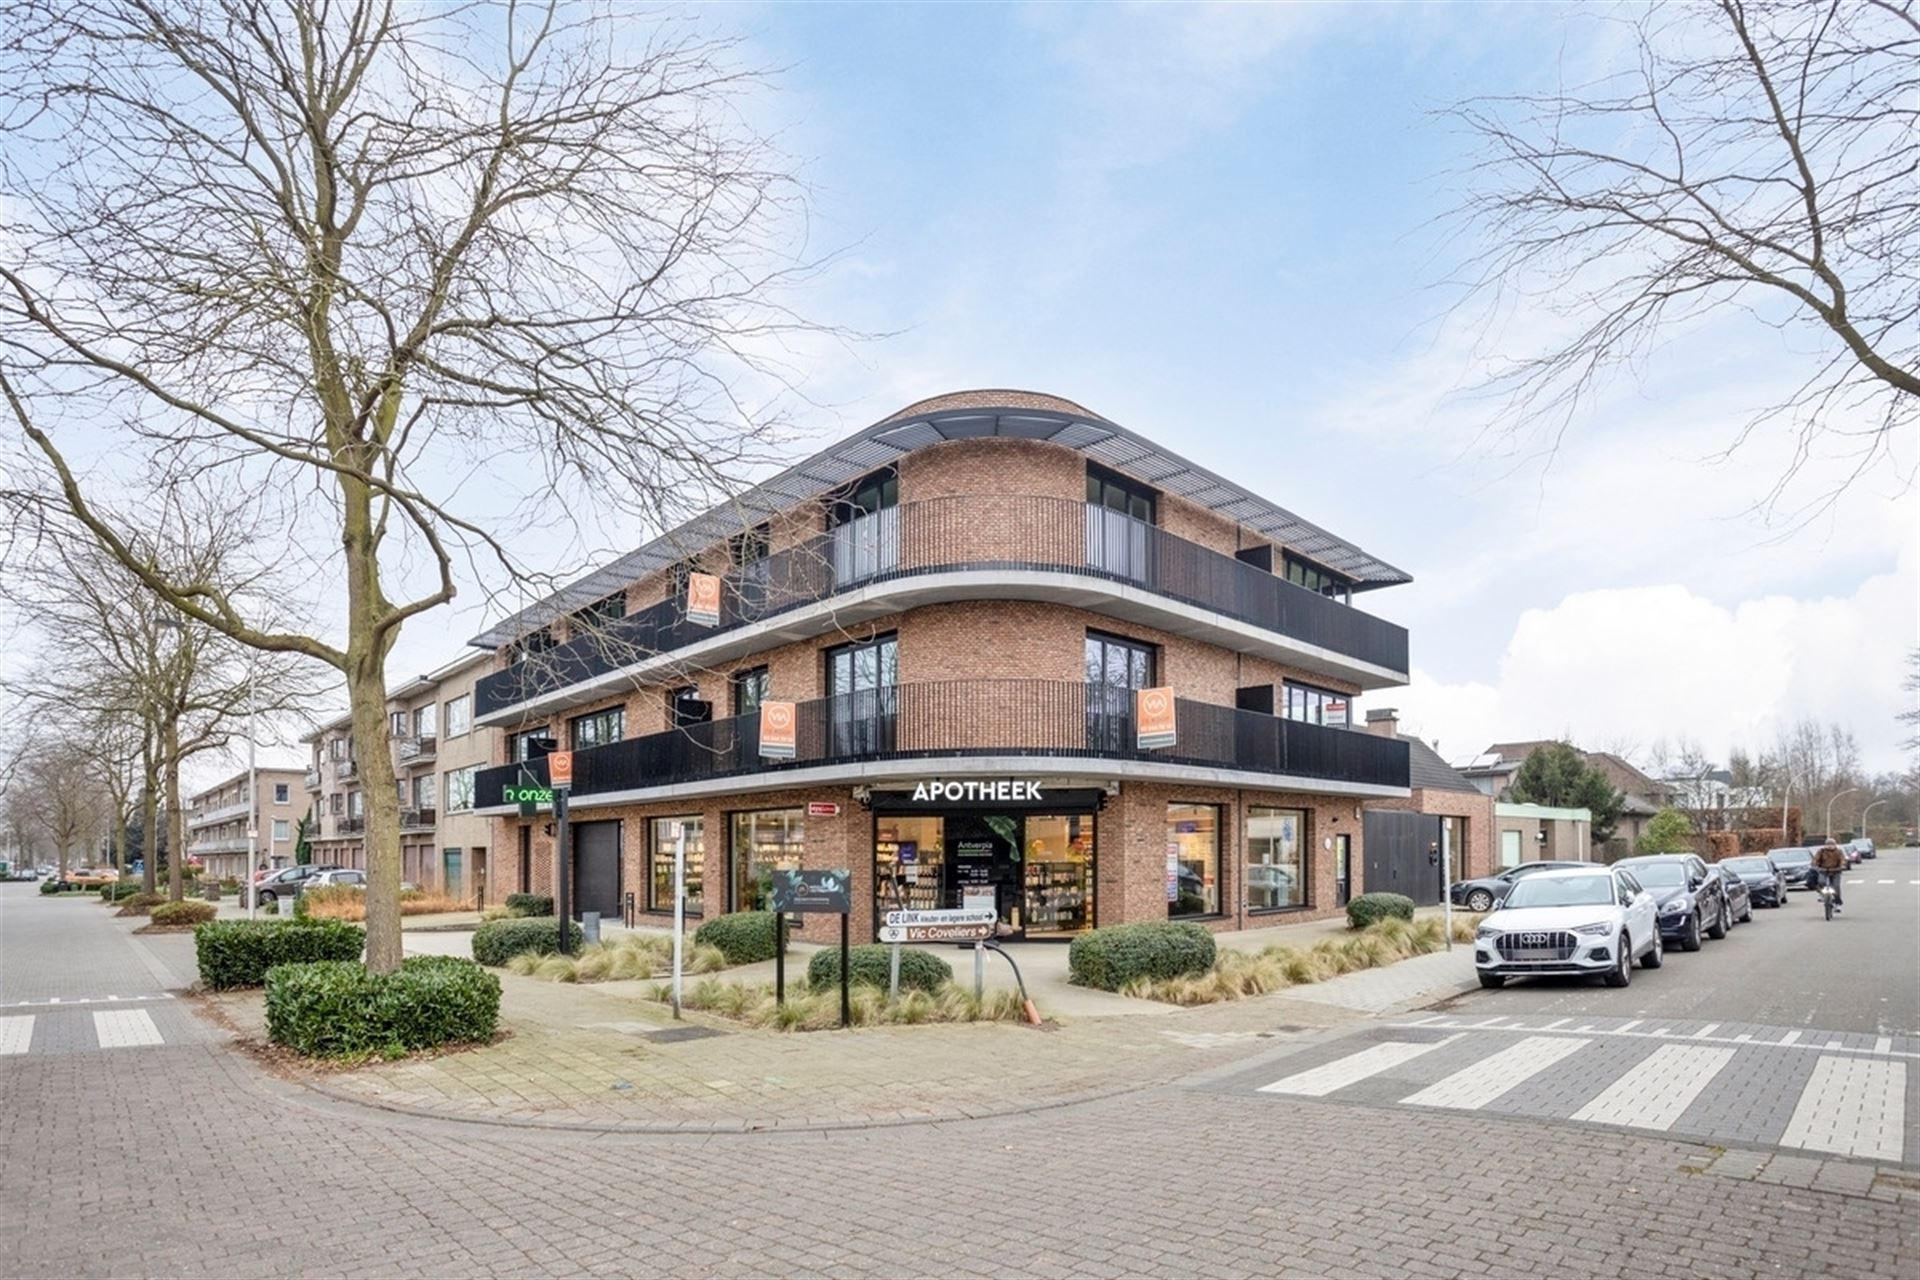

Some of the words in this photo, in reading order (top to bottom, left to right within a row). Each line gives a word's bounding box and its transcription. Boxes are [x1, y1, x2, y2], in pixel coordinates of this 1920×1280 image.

[912, 781, 1042, 801] APOTHEEK
[889, 912, 900, 924] DE
[902, 911, 919, 924] LINK
[909, 926, 926, 939] Vic
